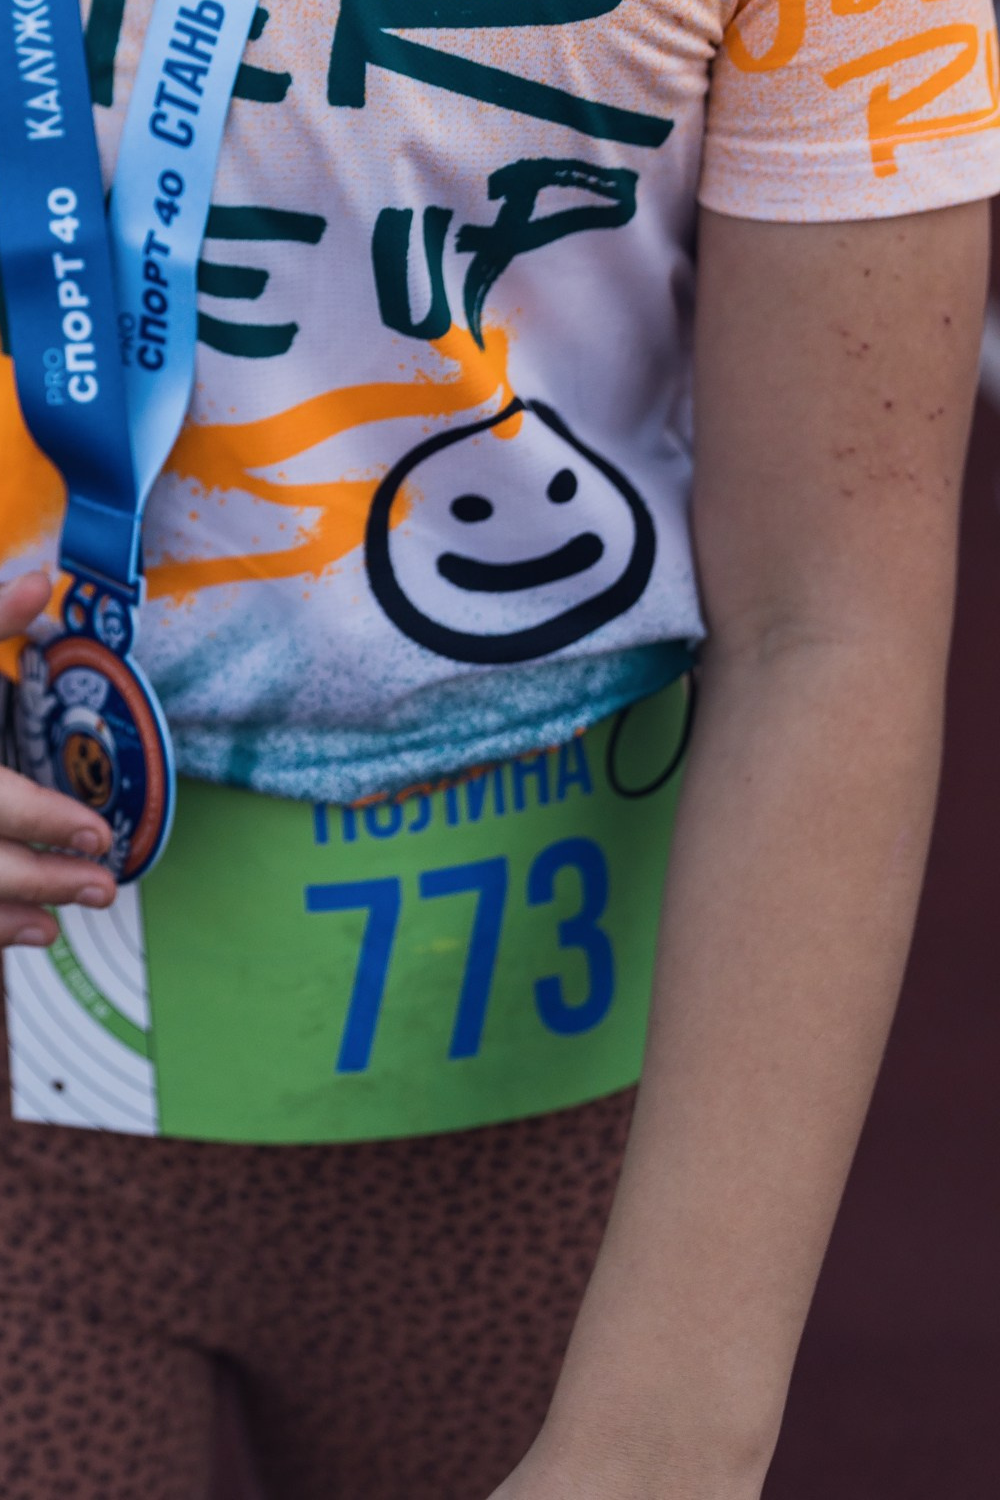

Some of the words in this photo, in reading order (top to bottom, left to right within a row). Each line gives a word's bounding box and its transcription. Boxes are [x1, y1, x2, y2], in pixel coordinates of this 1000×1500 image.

[149, 3, 227, 150] СТАНЬ
[47, 187, 79, 246] 40
[153, 168, 187, 222] 40
[53, 251, 99, 404] СПОРТ
[136, 229, 175, 372] СПОРТ
[303, 834, 617, 1075] 773
